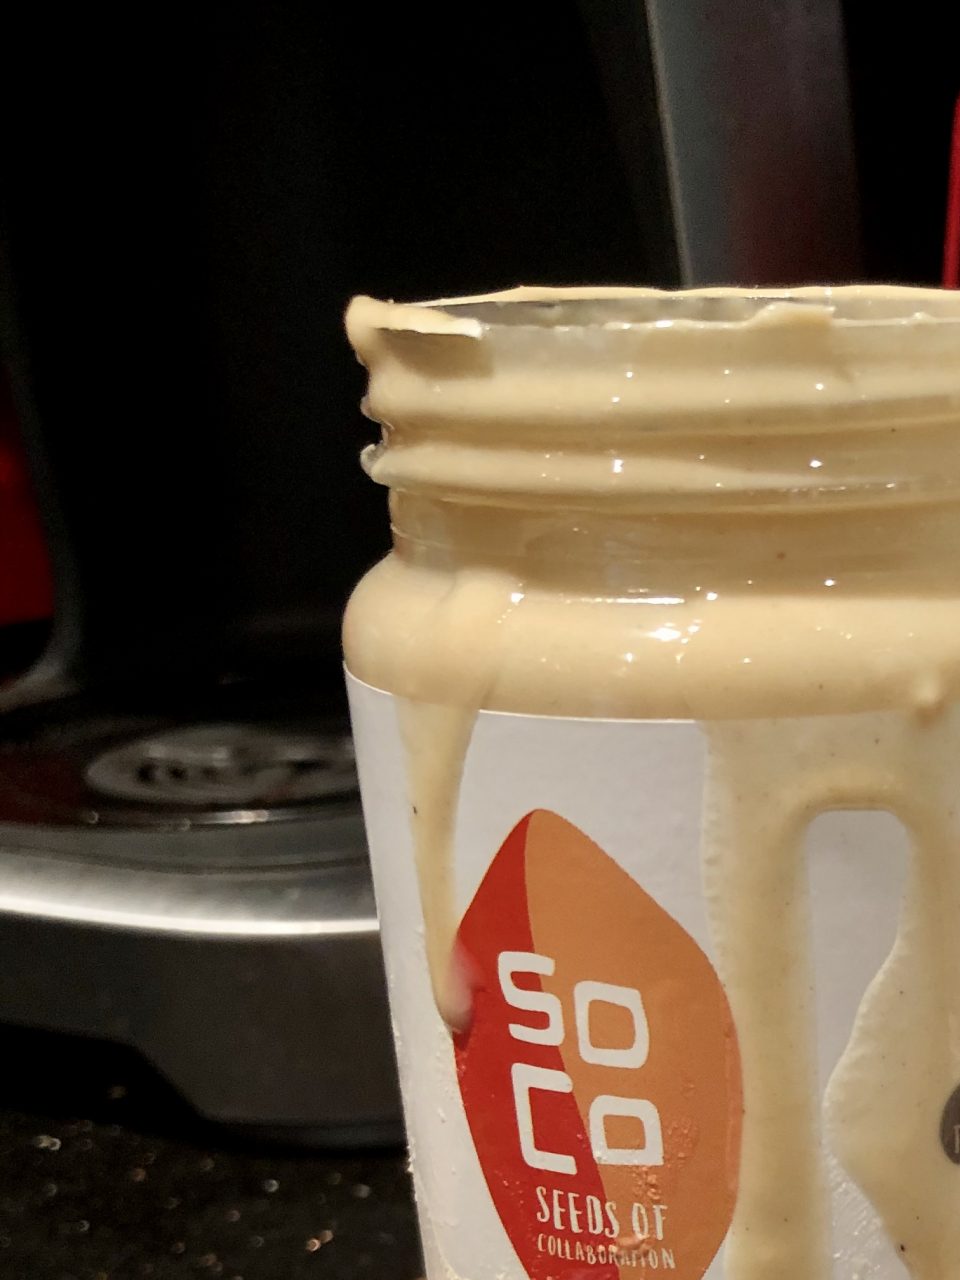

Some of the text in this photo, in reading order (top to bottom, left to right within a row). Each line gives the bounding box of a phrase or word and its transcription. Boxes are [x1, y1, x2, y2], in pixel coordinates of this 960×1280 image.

[498, 951, 650, 1069] SO
[511, 1062, 664, 1175] CO
[536, 1186, 620, 1239] SEEDS
